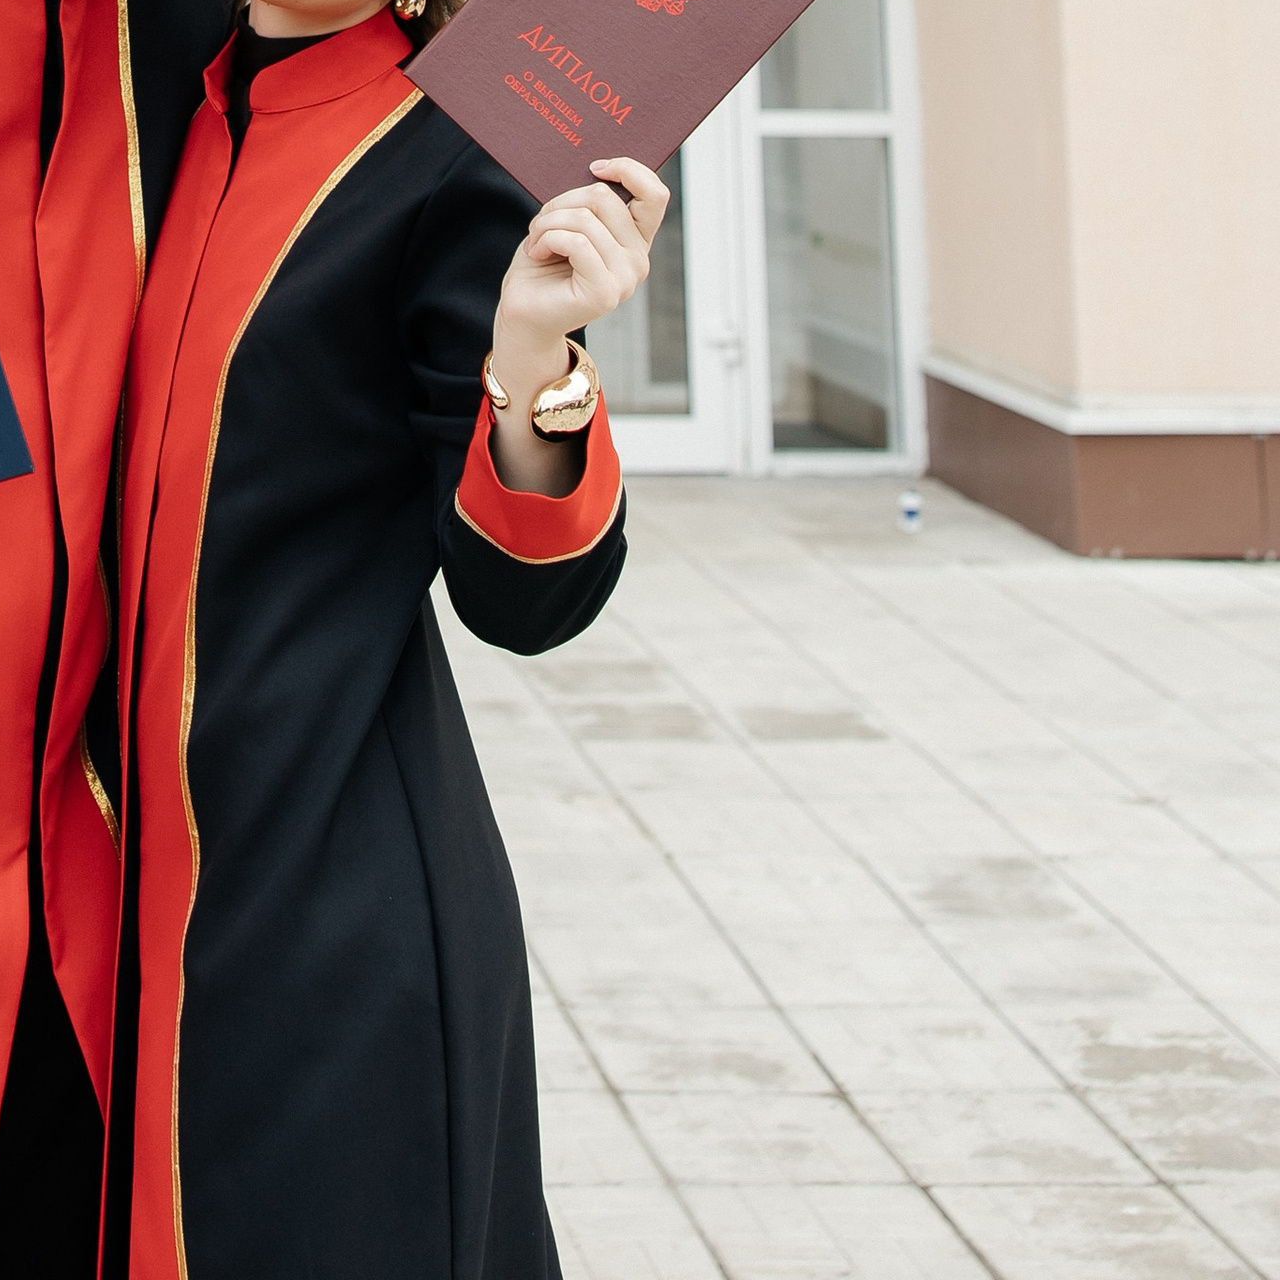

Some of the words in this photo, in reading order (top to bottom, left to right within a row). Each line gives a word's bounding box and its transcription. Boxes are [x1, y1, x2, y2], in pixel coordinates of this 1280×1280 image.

[504, 74, 582, 147] ОБРАЗОВАНИИ
[517, 25, 634, 125] ДИПЛОМ
[522, 70, 535, 82] О
[532, 80, 583, 127] ВЫСШЕМ
